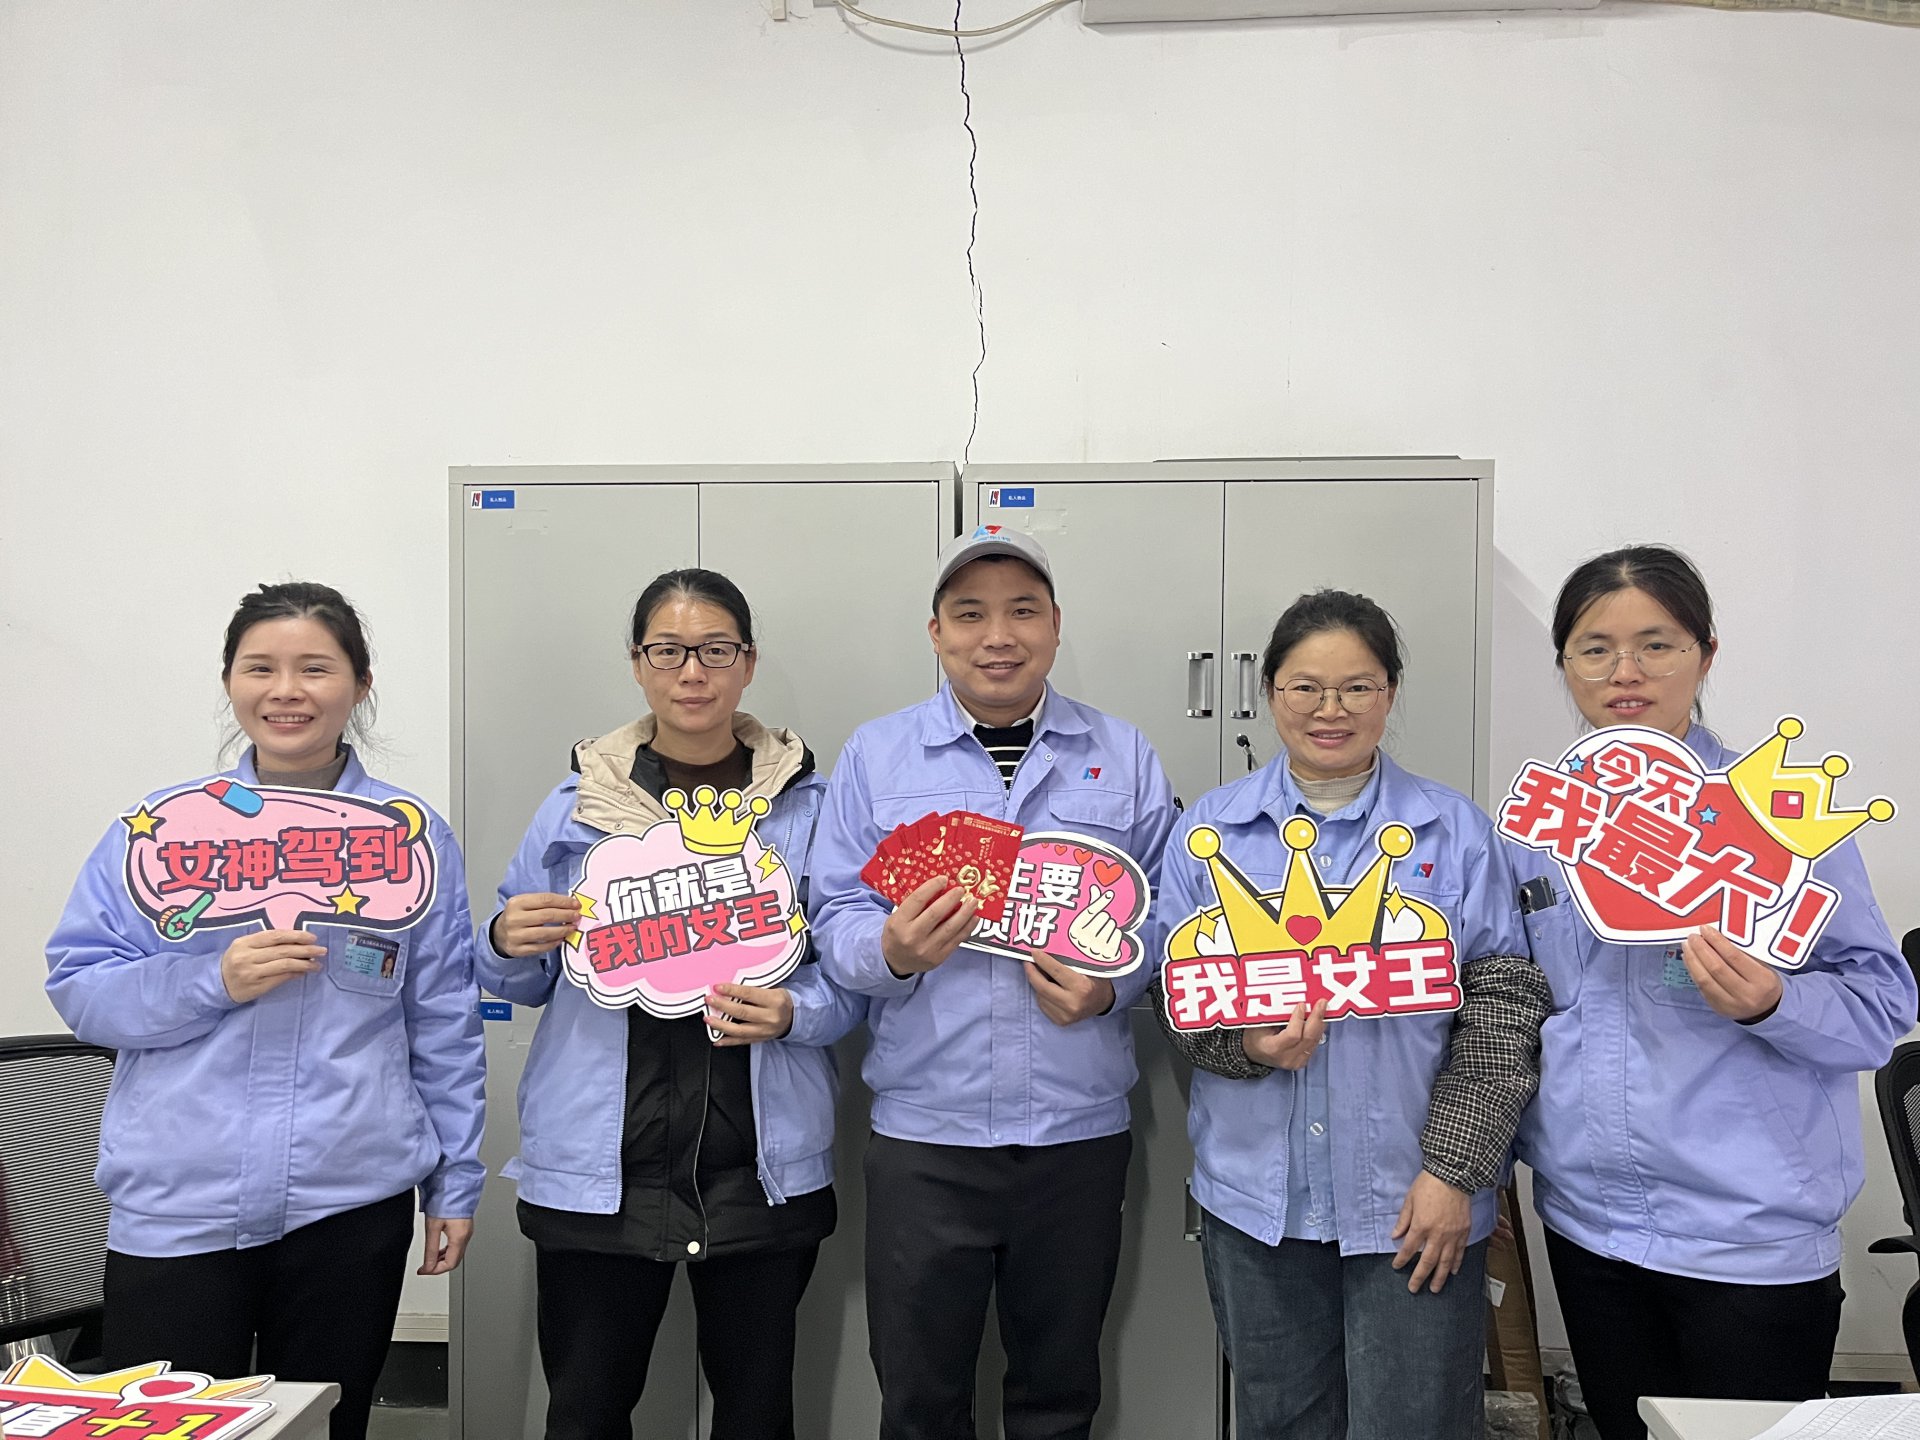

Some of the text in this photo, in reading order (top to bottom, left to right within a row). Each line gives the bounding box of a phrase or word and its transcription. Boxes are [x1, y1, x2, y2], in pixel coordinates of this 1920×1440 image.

[1598, 747, 1698, 817] 今天
[159, 826, 411, 892] 女神驾到
[607, 857, 755, 925] 你就是
[586, 890, 787, 973] 我的女王
[1171, 945, 1453, 1022] 我是女王
